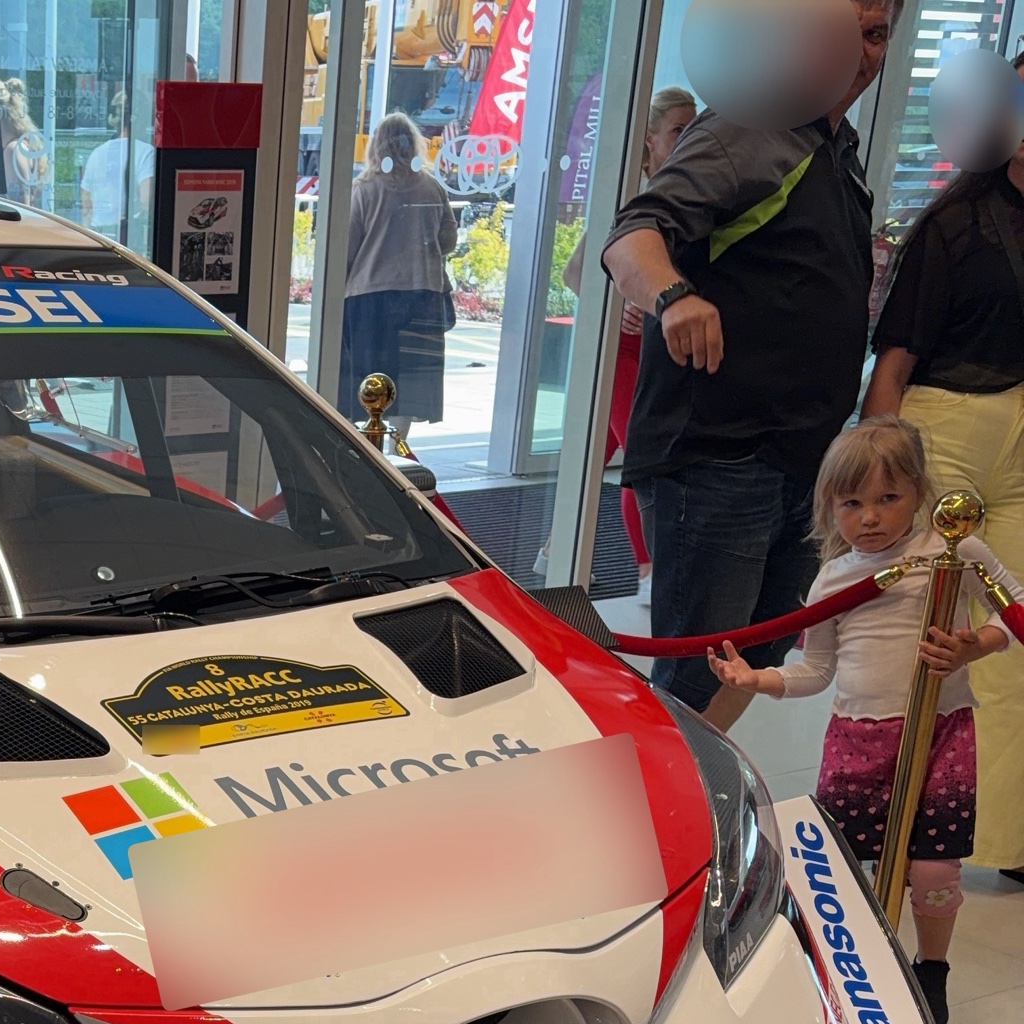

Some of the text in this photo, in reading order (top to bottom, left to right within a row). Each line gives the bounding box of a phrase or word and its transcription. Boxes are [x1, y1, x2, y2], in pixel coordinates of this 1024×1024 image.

[493, 0, 536, 124] AMS
[0, 264, 130, 287] Racing
[204, 663, 226, 677] 8
[166, 669, 303, 701] RallyRACC
[290, 681, 372, 700] DAURADA
[212, 699, 312, 722] Rally de España 2019
[728, 931, 754, 974] PIAA
